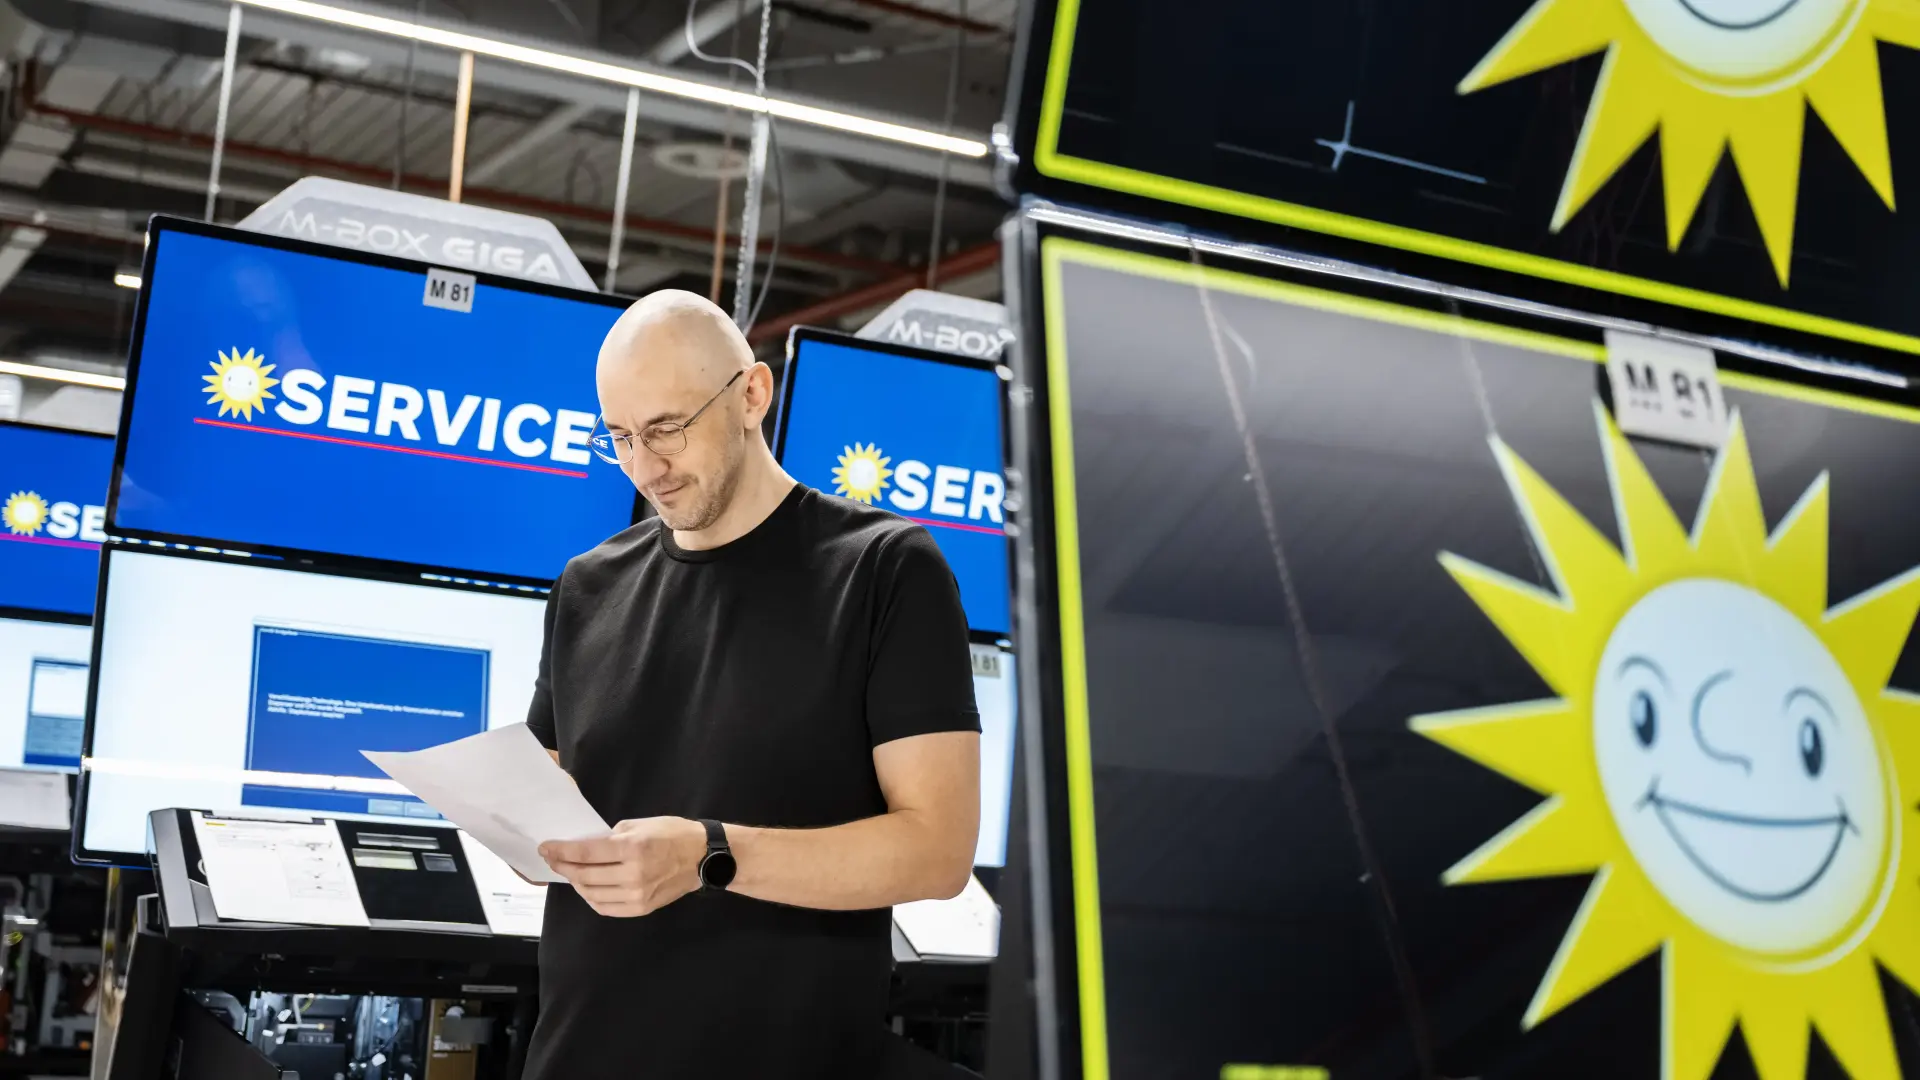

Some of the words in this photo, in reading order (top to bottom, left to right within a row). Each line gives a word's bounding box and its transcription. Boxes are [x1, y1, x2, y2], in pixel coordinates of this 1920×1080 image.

[442, 237, 562, 280] GIGA
[430, 279, 446, 300] M
[450, 284, 471, 304] 81
[274, 368, 599, 466] SERVICE
[888, 459, 1006, 524] SER
[46, 501, 108, 543] SE
